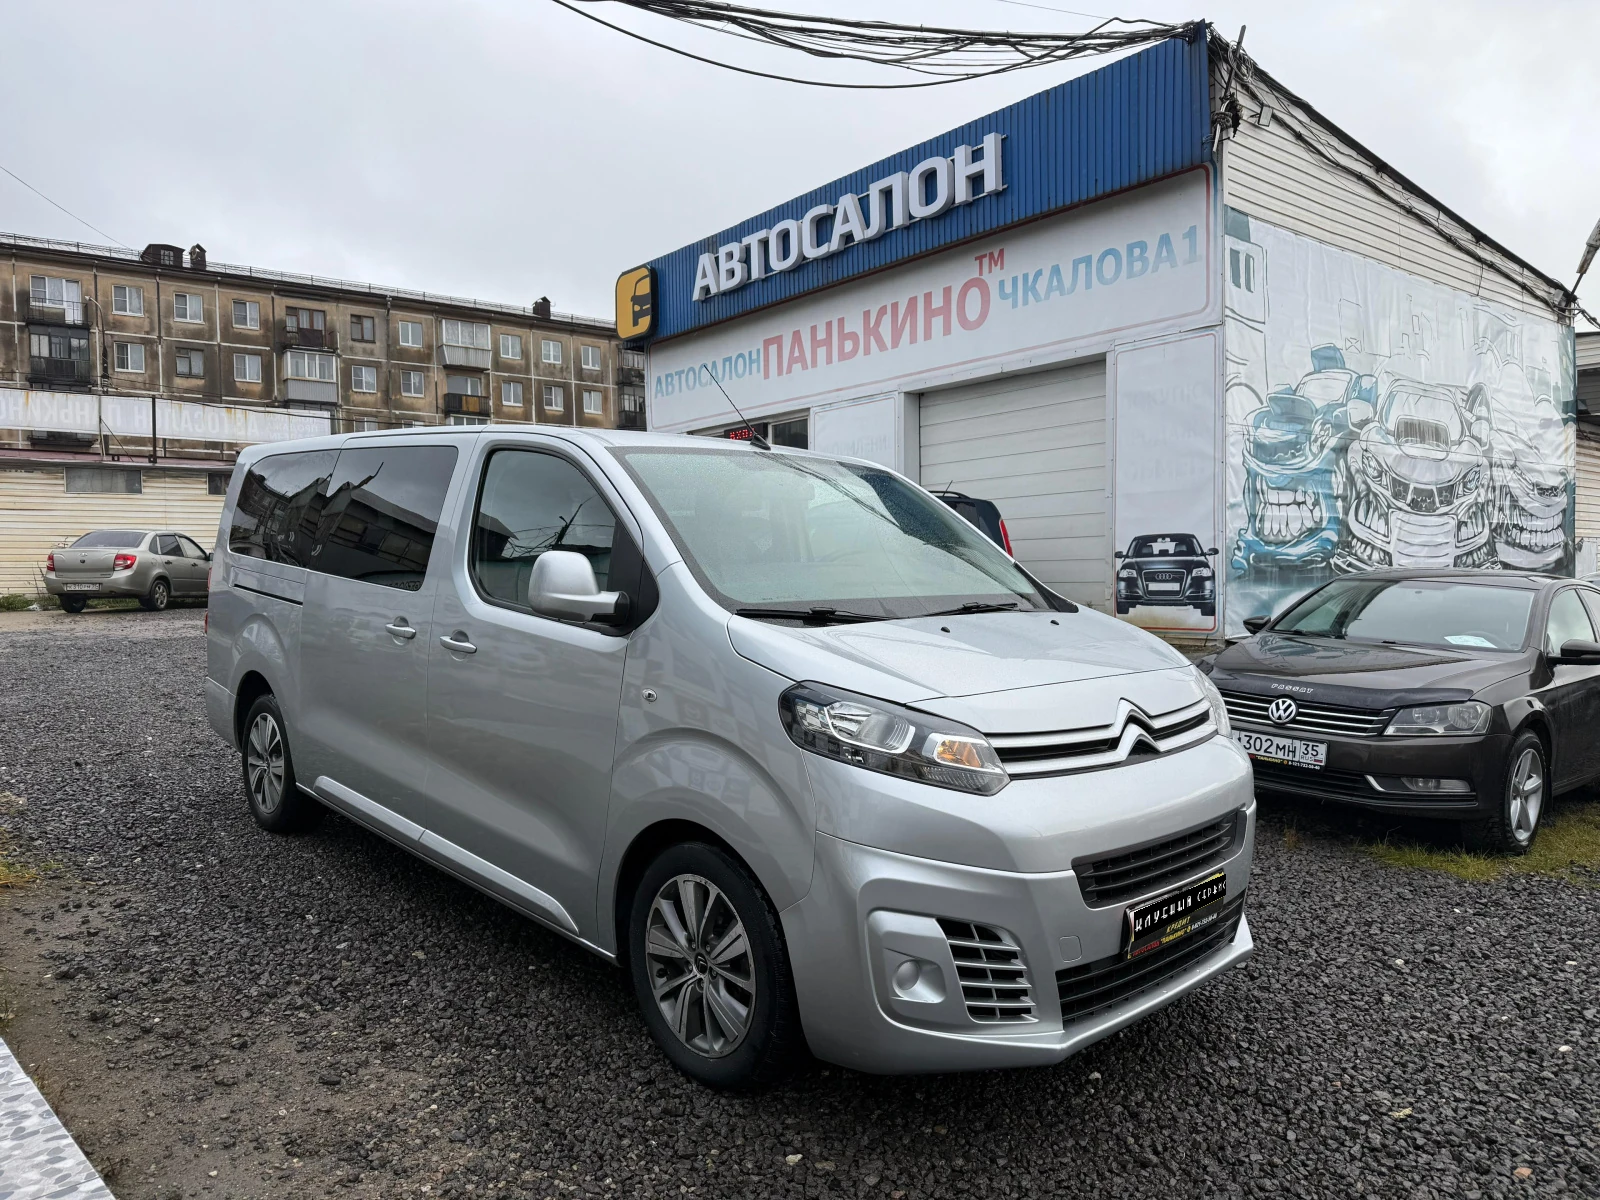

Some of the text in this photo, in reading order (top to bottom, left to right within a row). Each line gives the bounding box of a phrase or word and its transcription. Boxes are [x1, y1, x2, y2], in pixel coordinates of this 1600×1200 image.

[692, 131, 1004, 301] АВТОСАЛОН
[654, 348, 761, 400] АВТОСАЛОН
[763, 277, 991, 380] ПАНЬКИНО
[1237, 734, 1319, 758] 302МН 35
